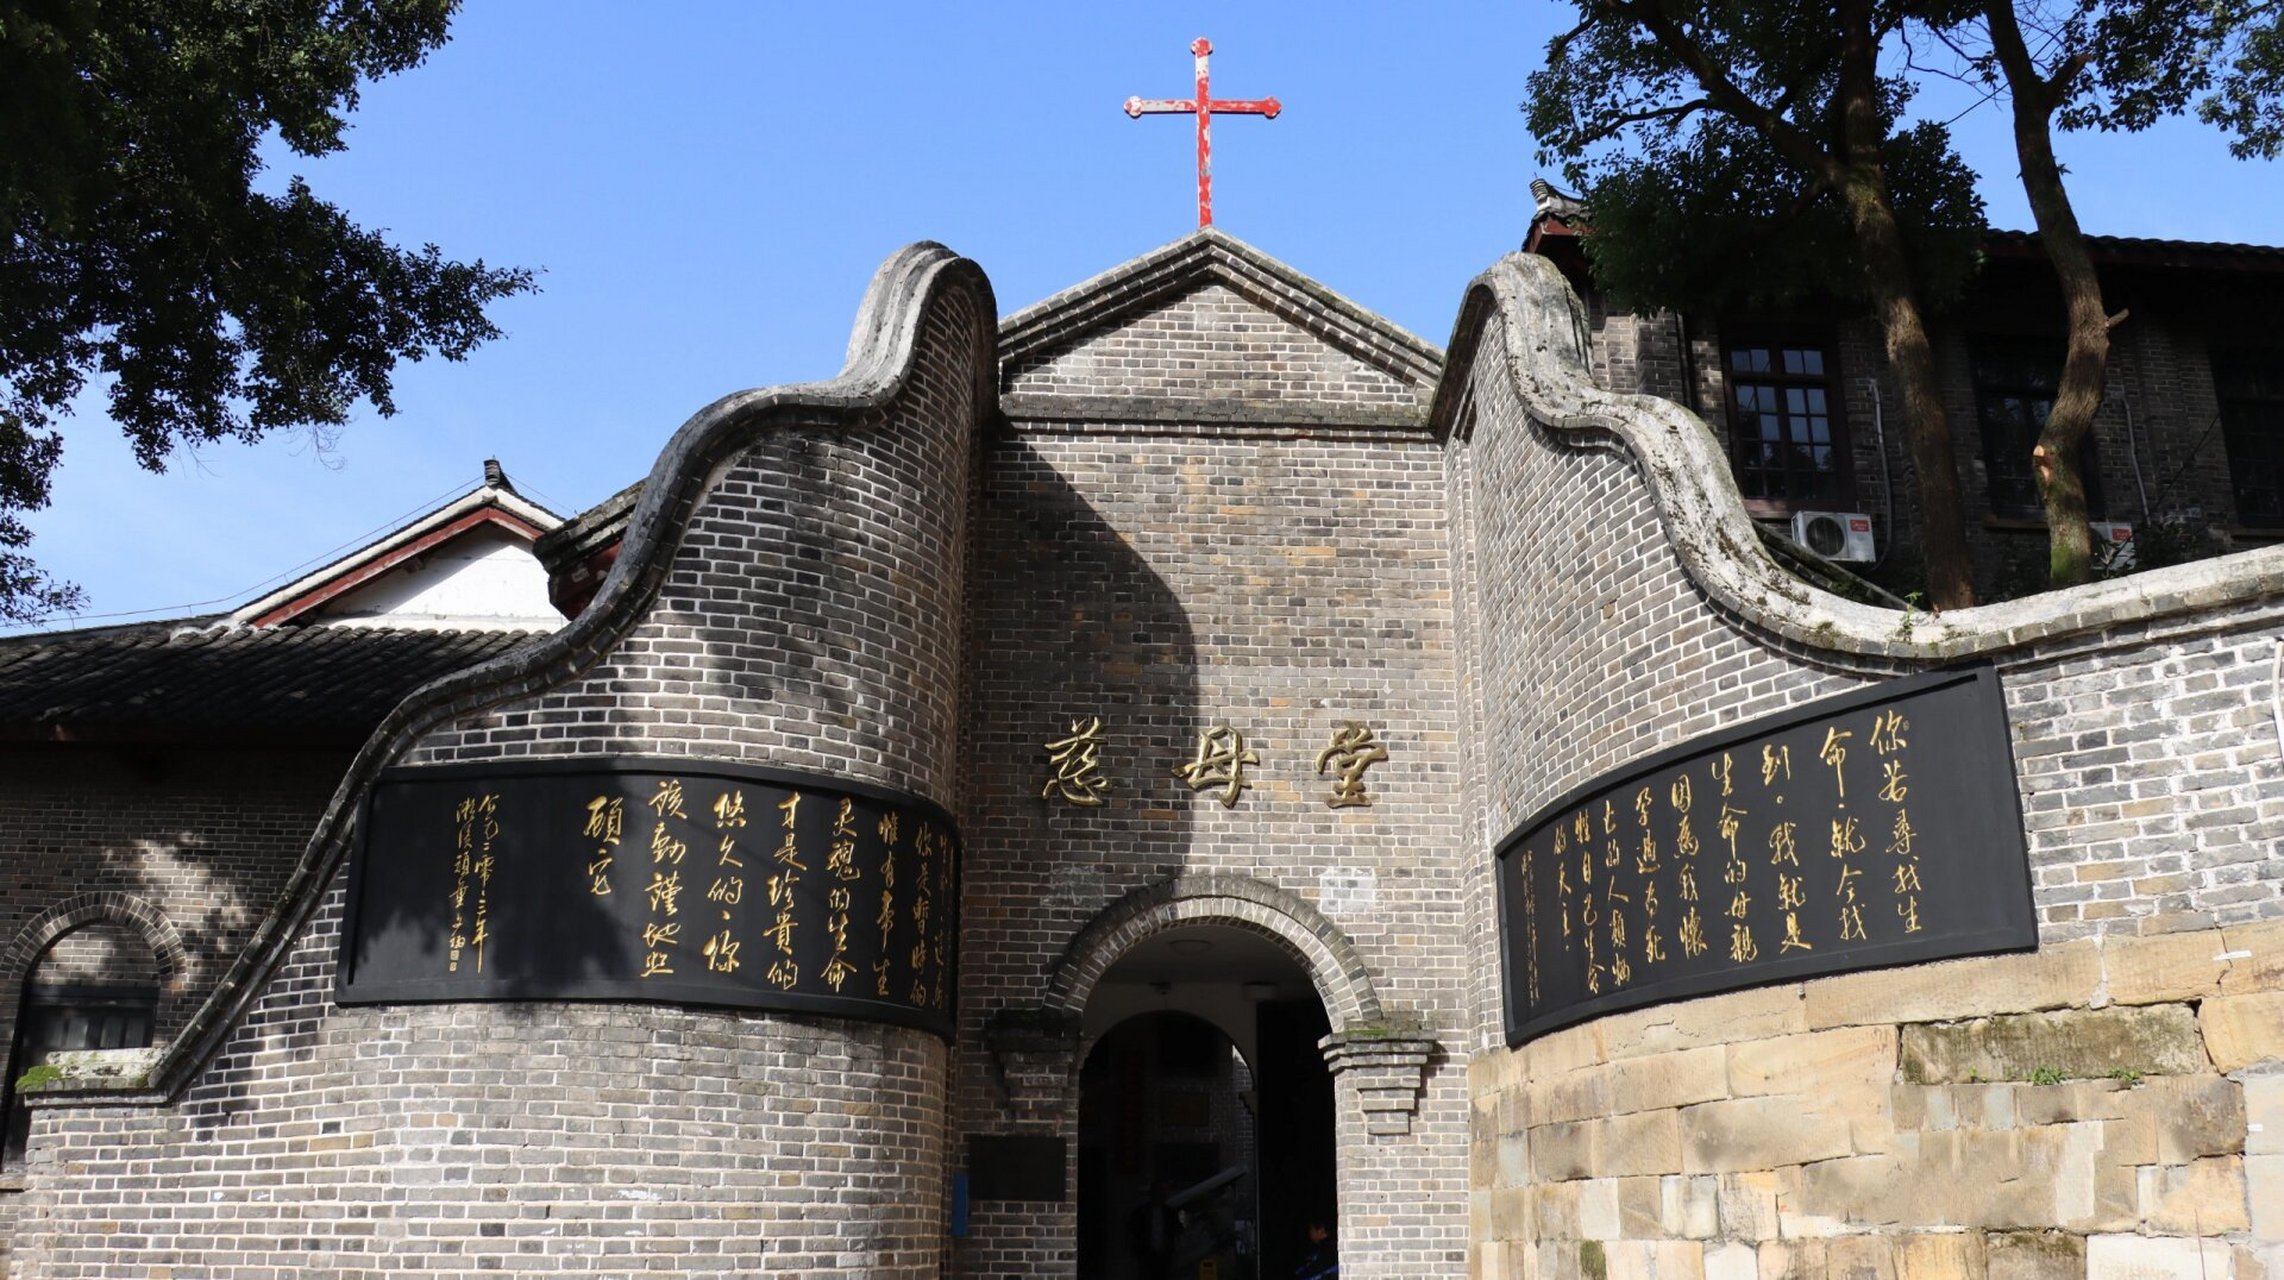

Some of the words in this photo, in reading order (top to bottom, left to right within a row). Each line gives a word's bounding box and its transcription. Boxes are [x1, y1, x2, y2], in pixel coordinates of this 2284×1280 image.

[1042, 716, 1389, 809] 慈母堂
[583, 795, 623, 897] 顧它
[762, 791, 808, 990] 才是珍貴的
